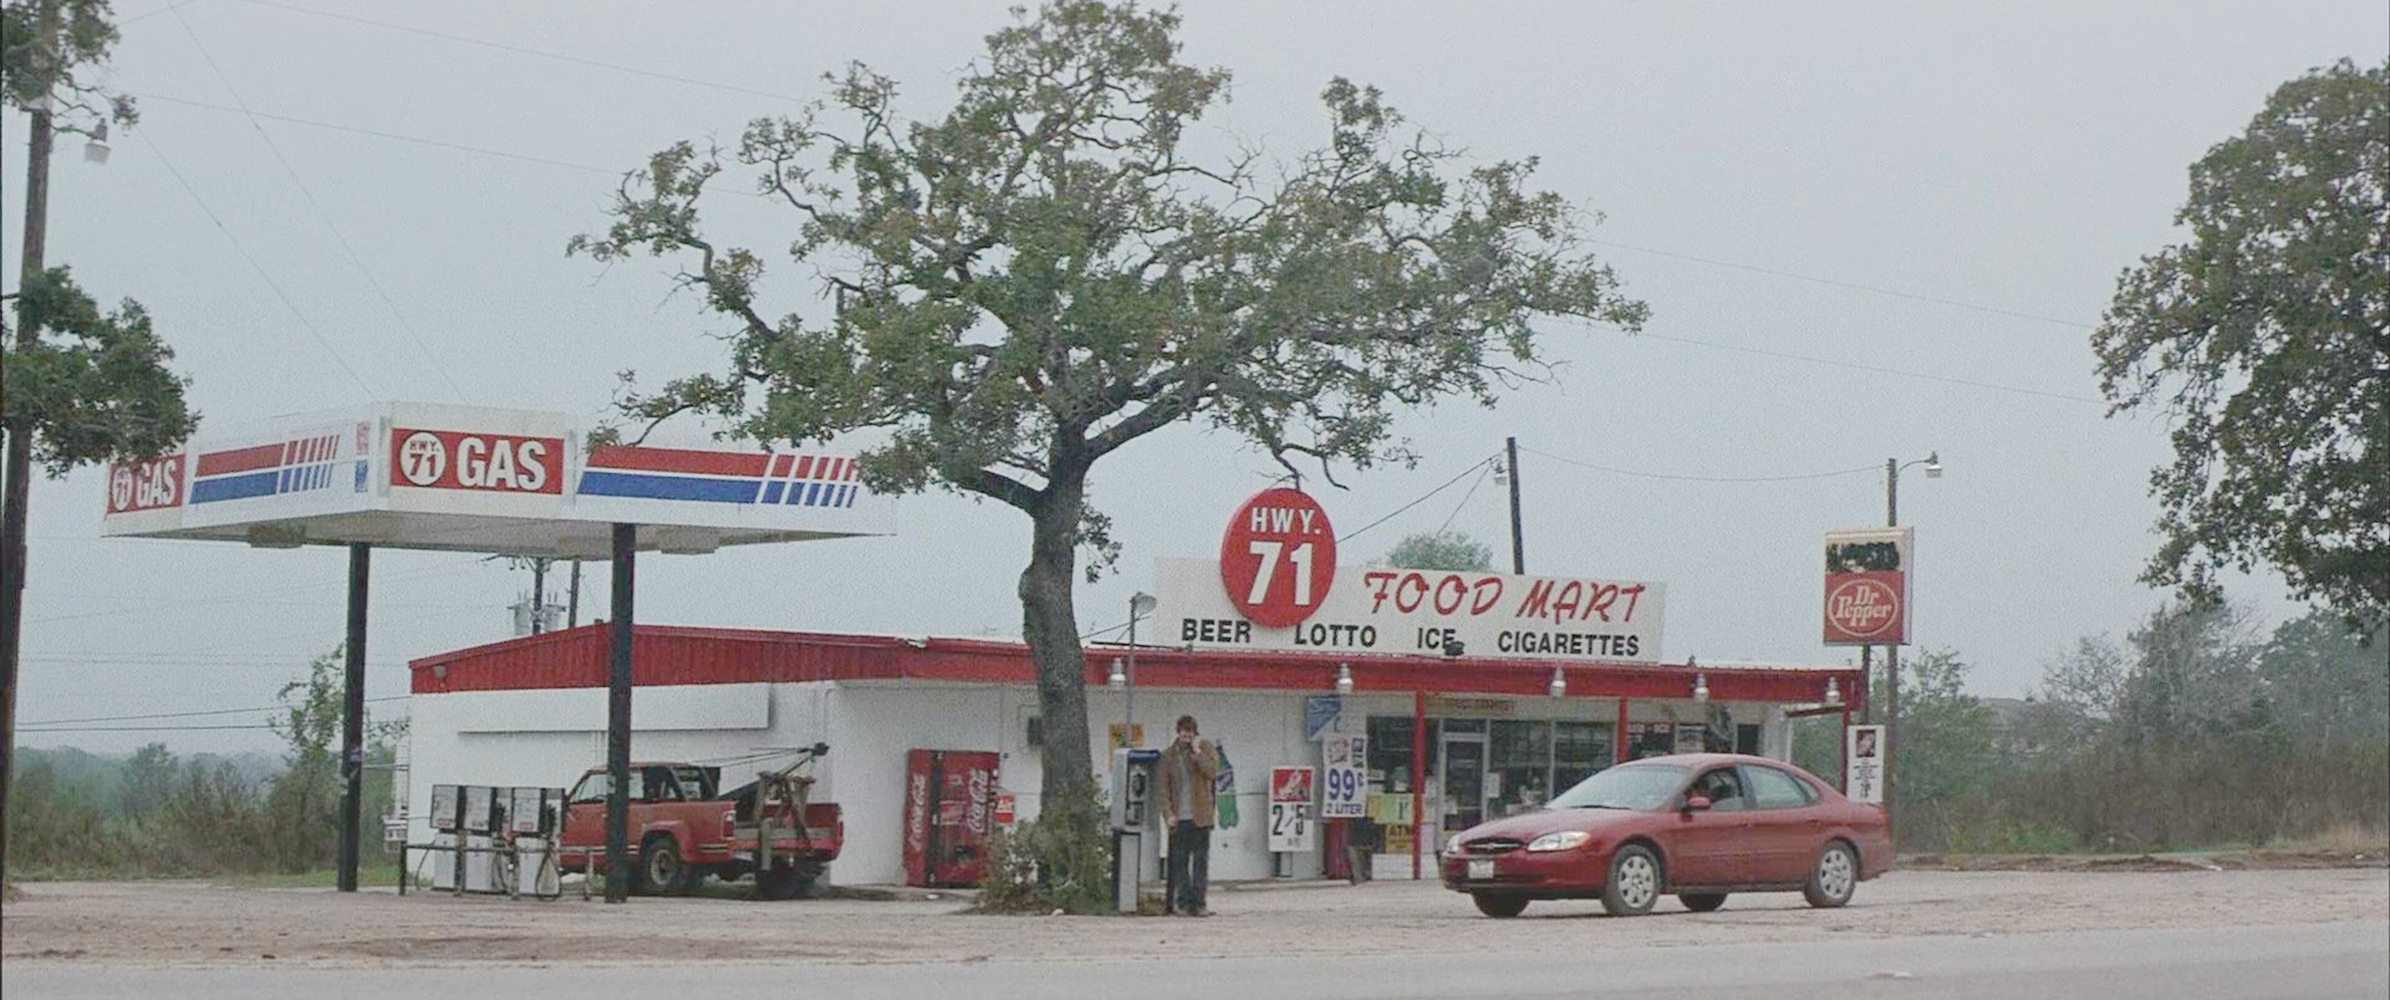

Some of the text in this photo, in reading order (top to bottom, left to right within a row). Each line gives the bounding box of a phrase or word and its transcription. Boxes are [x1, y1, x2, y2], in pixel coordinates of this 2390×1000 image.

[410, 441, 440, 452] HWY.
[456, 436, 547, 491] GAS
[409, 453, 437, 477] 71
[135, 460, 177, 507] GAS
[1251, 506, 1321, 535] HWY.
[1247, 540, 1313, 606] 71
[1364, 572, 1646, 625] FOOD MART
[1835, 595, 1892, 628] Pepper
[1854, 585, 1880, 606] Dr
[1181, 618, 1640, 657] BEER LOTTO ICE CIGARETTES
